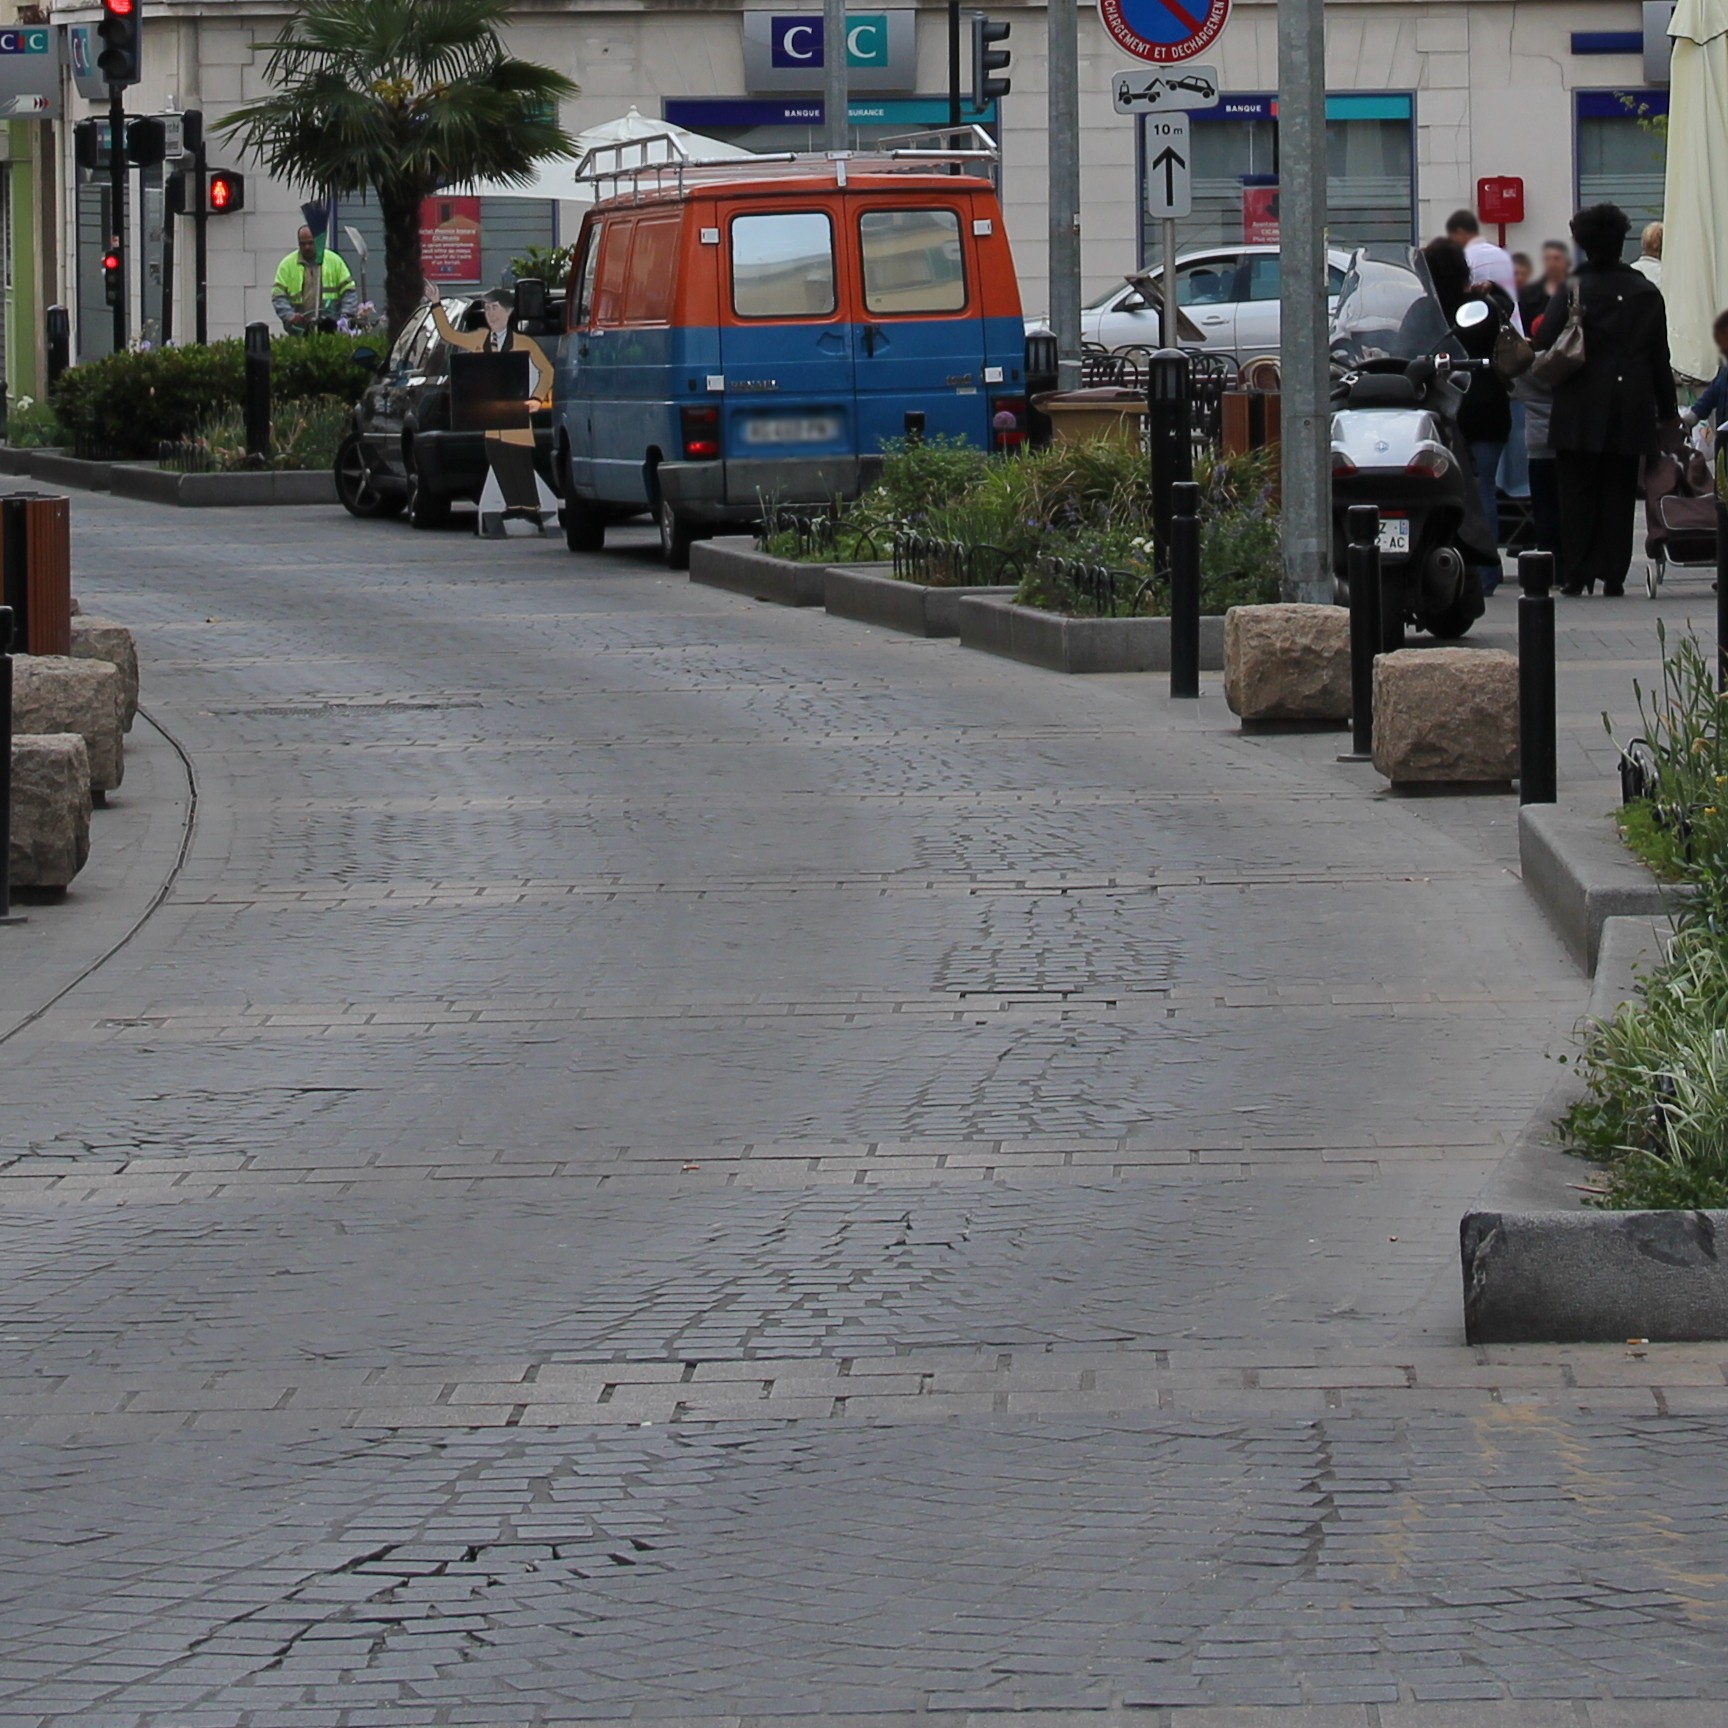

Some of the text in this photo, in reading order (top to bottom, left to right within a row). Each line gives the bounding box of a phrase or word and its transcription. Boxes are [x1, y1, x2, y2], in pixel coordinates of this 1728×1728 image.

[1104, 0, 1151, 55] CHARGEMENT
[1154, 47, 1166, 59] ET
[783, 25, 877, 59] CC
[784, 108, 885, 117] BANQUE SURANCE
[1225, 105, 1262, 113] BANQUE
[1154, 124, 1183, 135] 10 m
